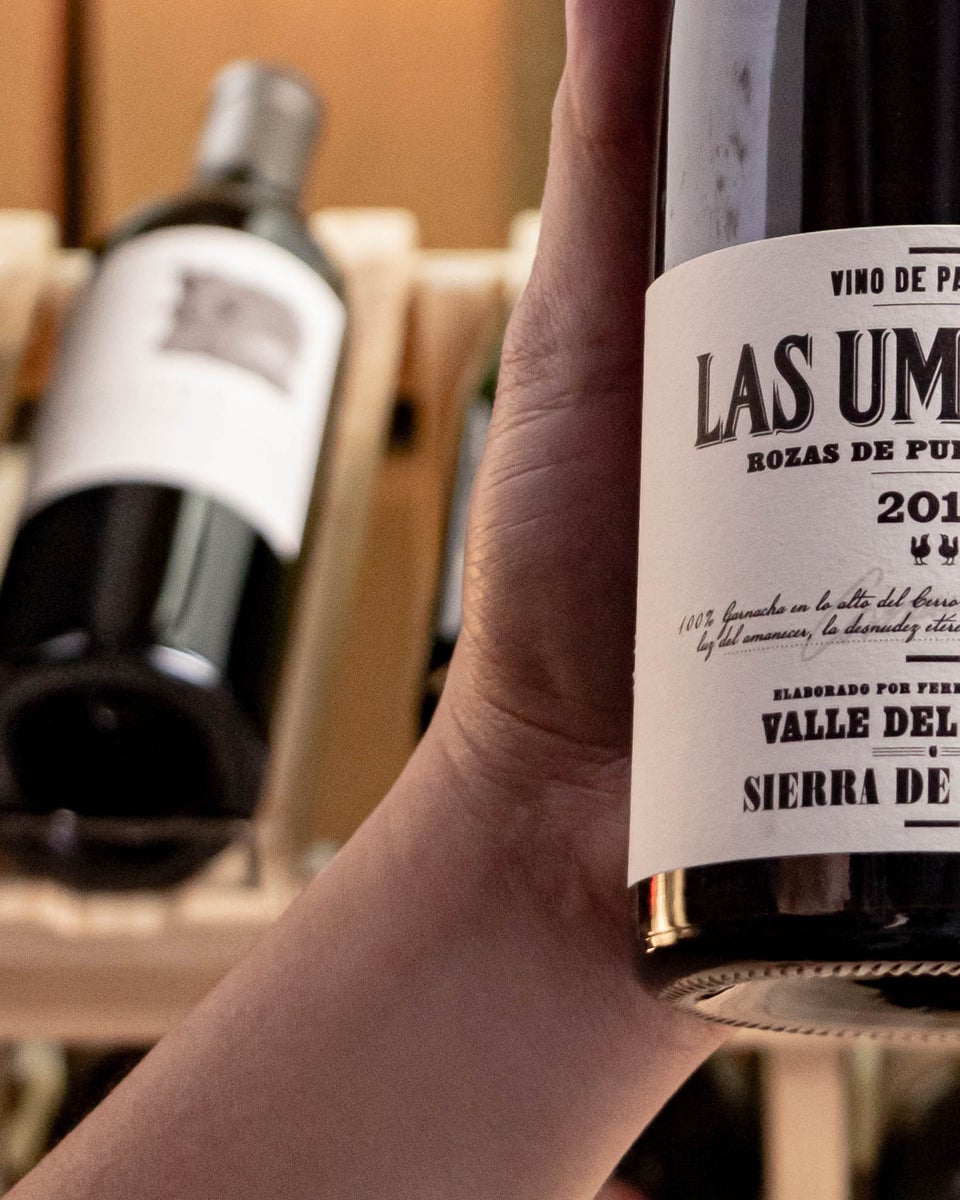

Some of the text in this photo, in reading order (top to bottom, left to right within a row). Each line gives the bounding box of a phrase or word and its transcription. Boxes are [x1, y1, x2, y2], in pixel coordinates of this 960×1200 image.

[831, 267, 884, 296] VINO
[895, 266, 926, 293] DE
[694, 333, 814, 449] LAS
[747, 443, 840, 473] ROZAS
[851, 440, 894, 461] DE
[679, 609, 715, 635] 100%
[718, 593, 787, 639] Garnacha
[790, 604, 810, 613] en
[815, 589, 831, 611] lo
[836, 587, 876, 609] alto
[876, 586, 911, 608] del
[911, 585, 960, 608] Cerro
[696, 630, 716, 662] luz
[718, 623, 744, 648] del
[742, 628, 813, 643] amanecer,
[822, 614, 839, 636] la
[844, 612, 921, 643] desnudez
[773, 683, 870, 701] ELABORADO
[877, 682, 911, 695] POR
[762, 706, 870, 744] VALLE
[883, 705, 958, 738] DEL
[743, 767, 880, 813] SIERRA
[895, 767, 950, 805] DE
